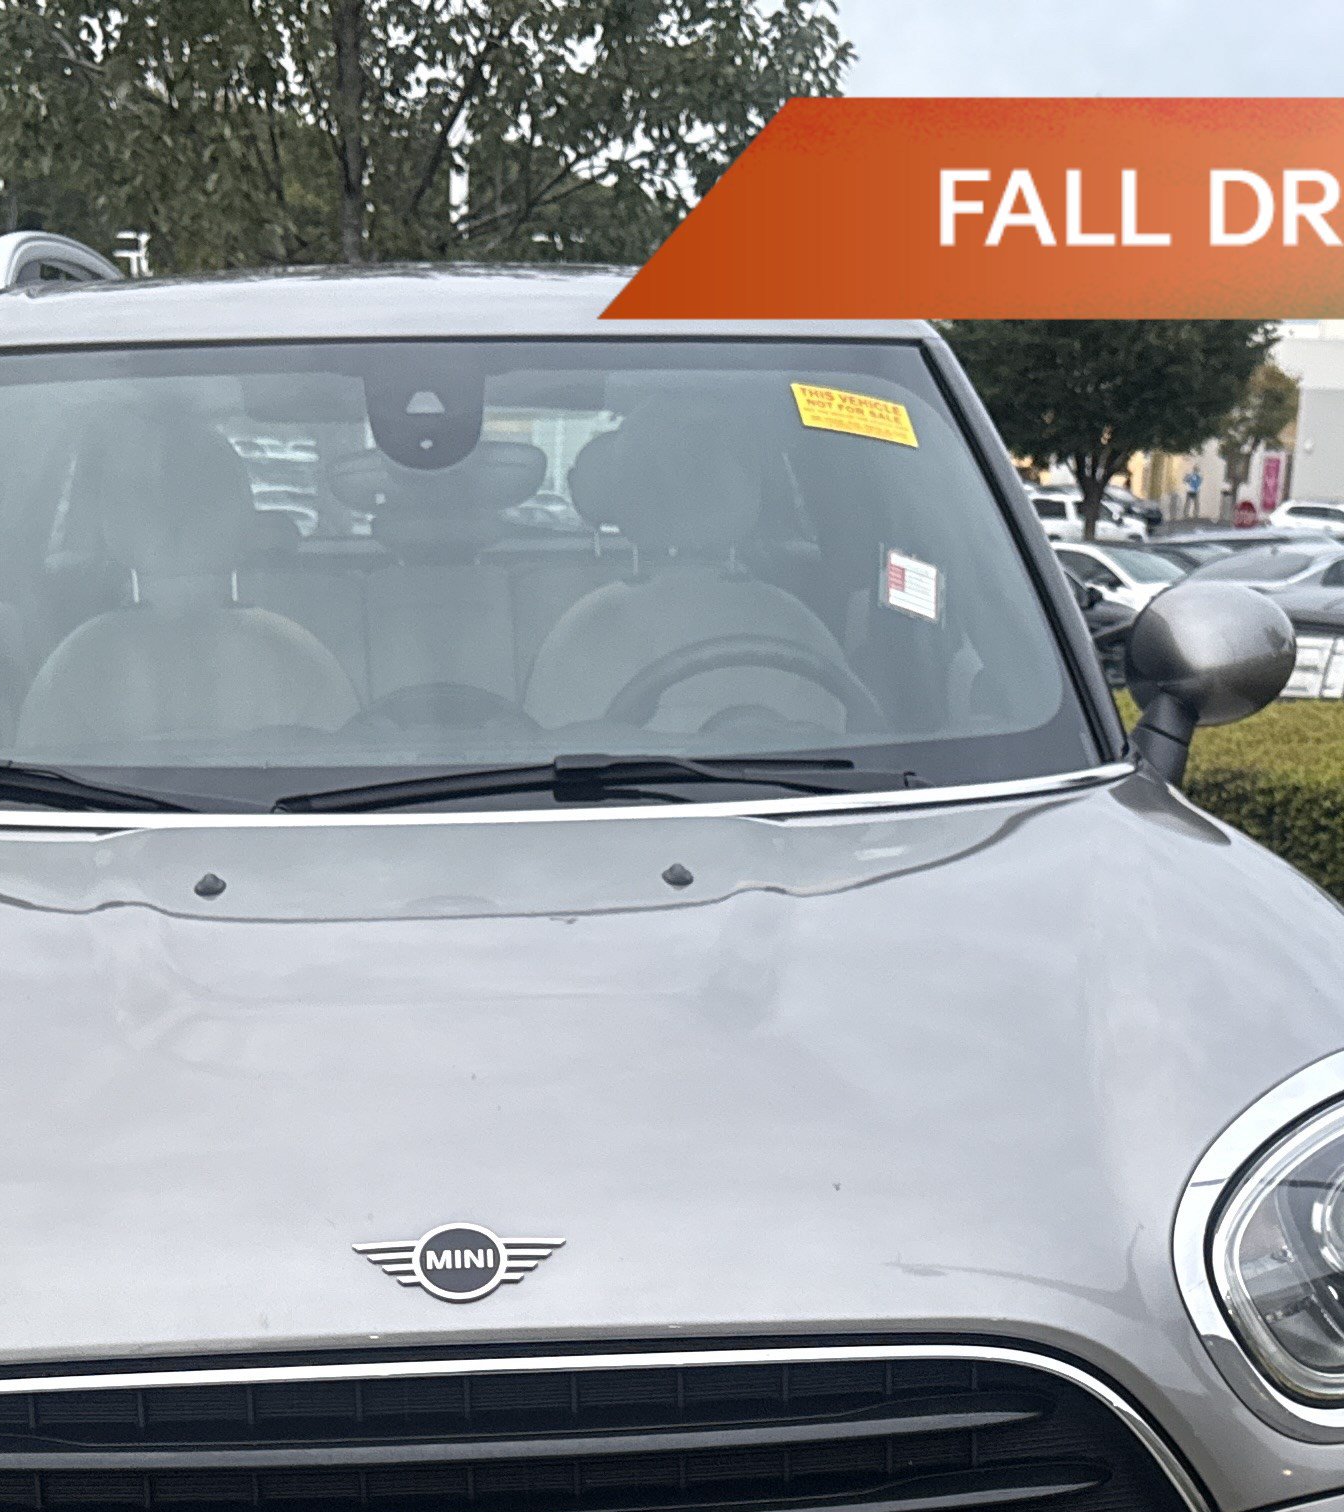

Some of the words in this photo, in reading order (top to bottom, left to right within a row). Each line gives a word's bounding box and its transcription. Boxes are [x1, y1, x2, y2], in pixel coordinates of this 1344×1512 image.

[800, 387, 835, 401] THIS
[838, 393, 899, 416] VEHICLE
[806, 398, 833, 409] NOT
[838, 403, 865, 416] FOR
[425, 1248, 494, 1270] MINI
